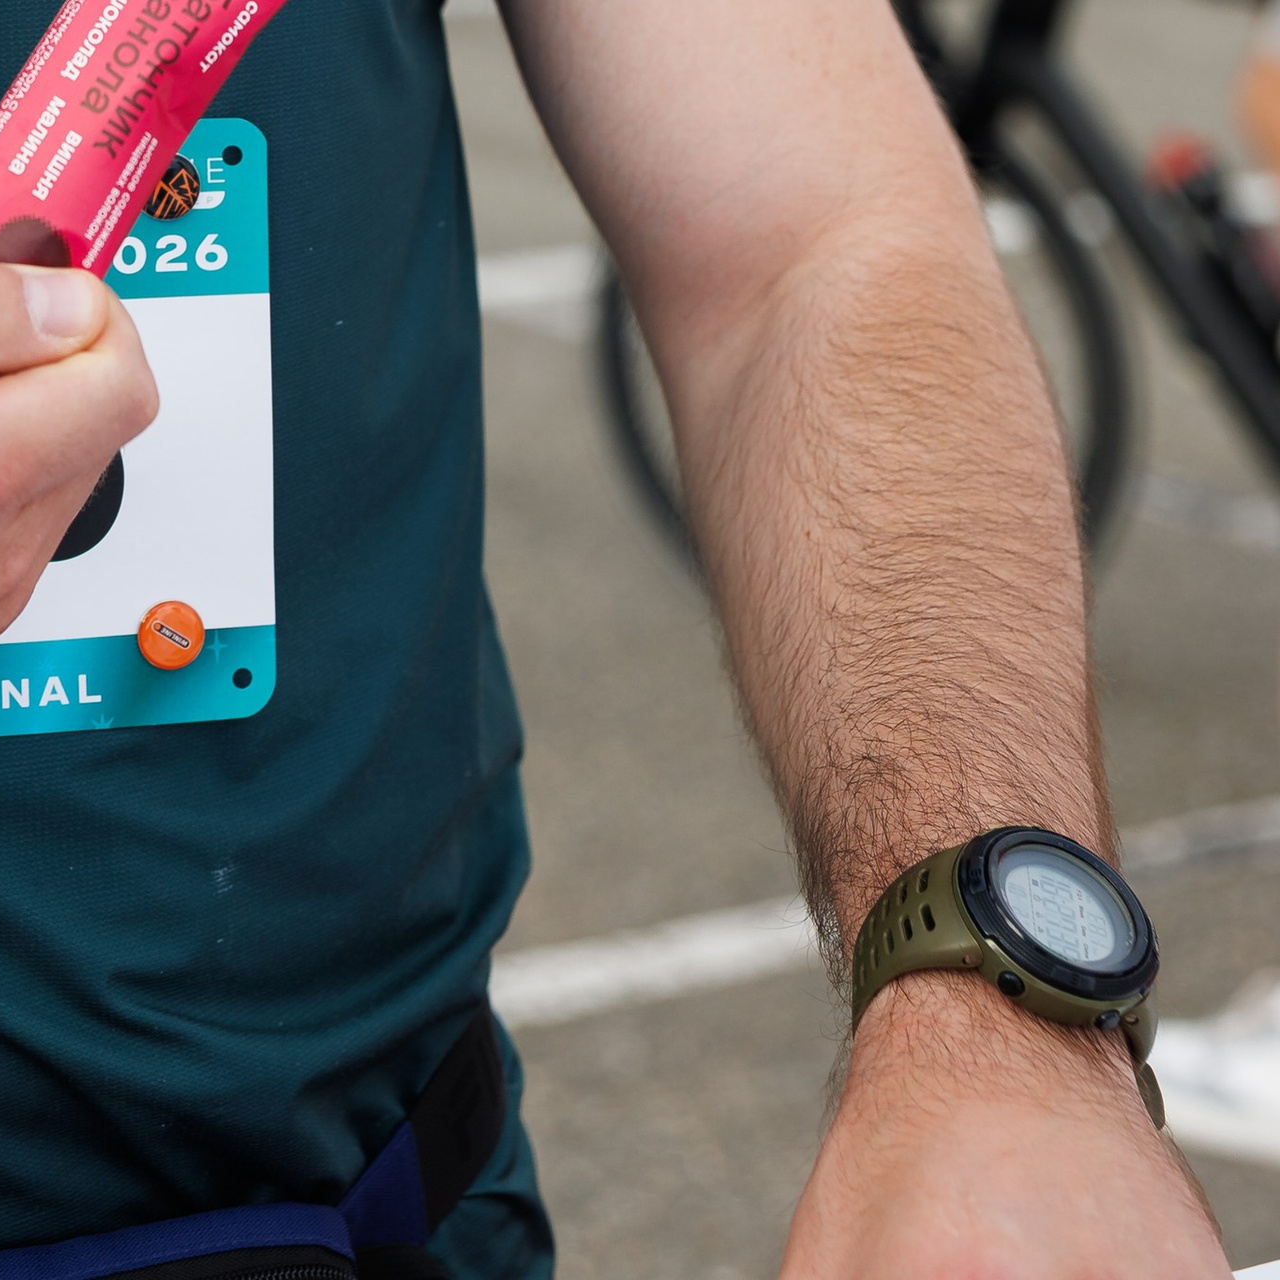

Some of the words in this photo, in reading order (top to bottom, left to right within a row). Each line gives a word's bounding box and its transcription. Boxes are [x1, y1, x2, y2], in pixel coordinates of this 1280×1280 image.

[200, 1, 258, 72] самокат
[9, 96, 66, 174] малина
[32, 131, 82, 200] вишня
[113, 234, 228, 274] 026
